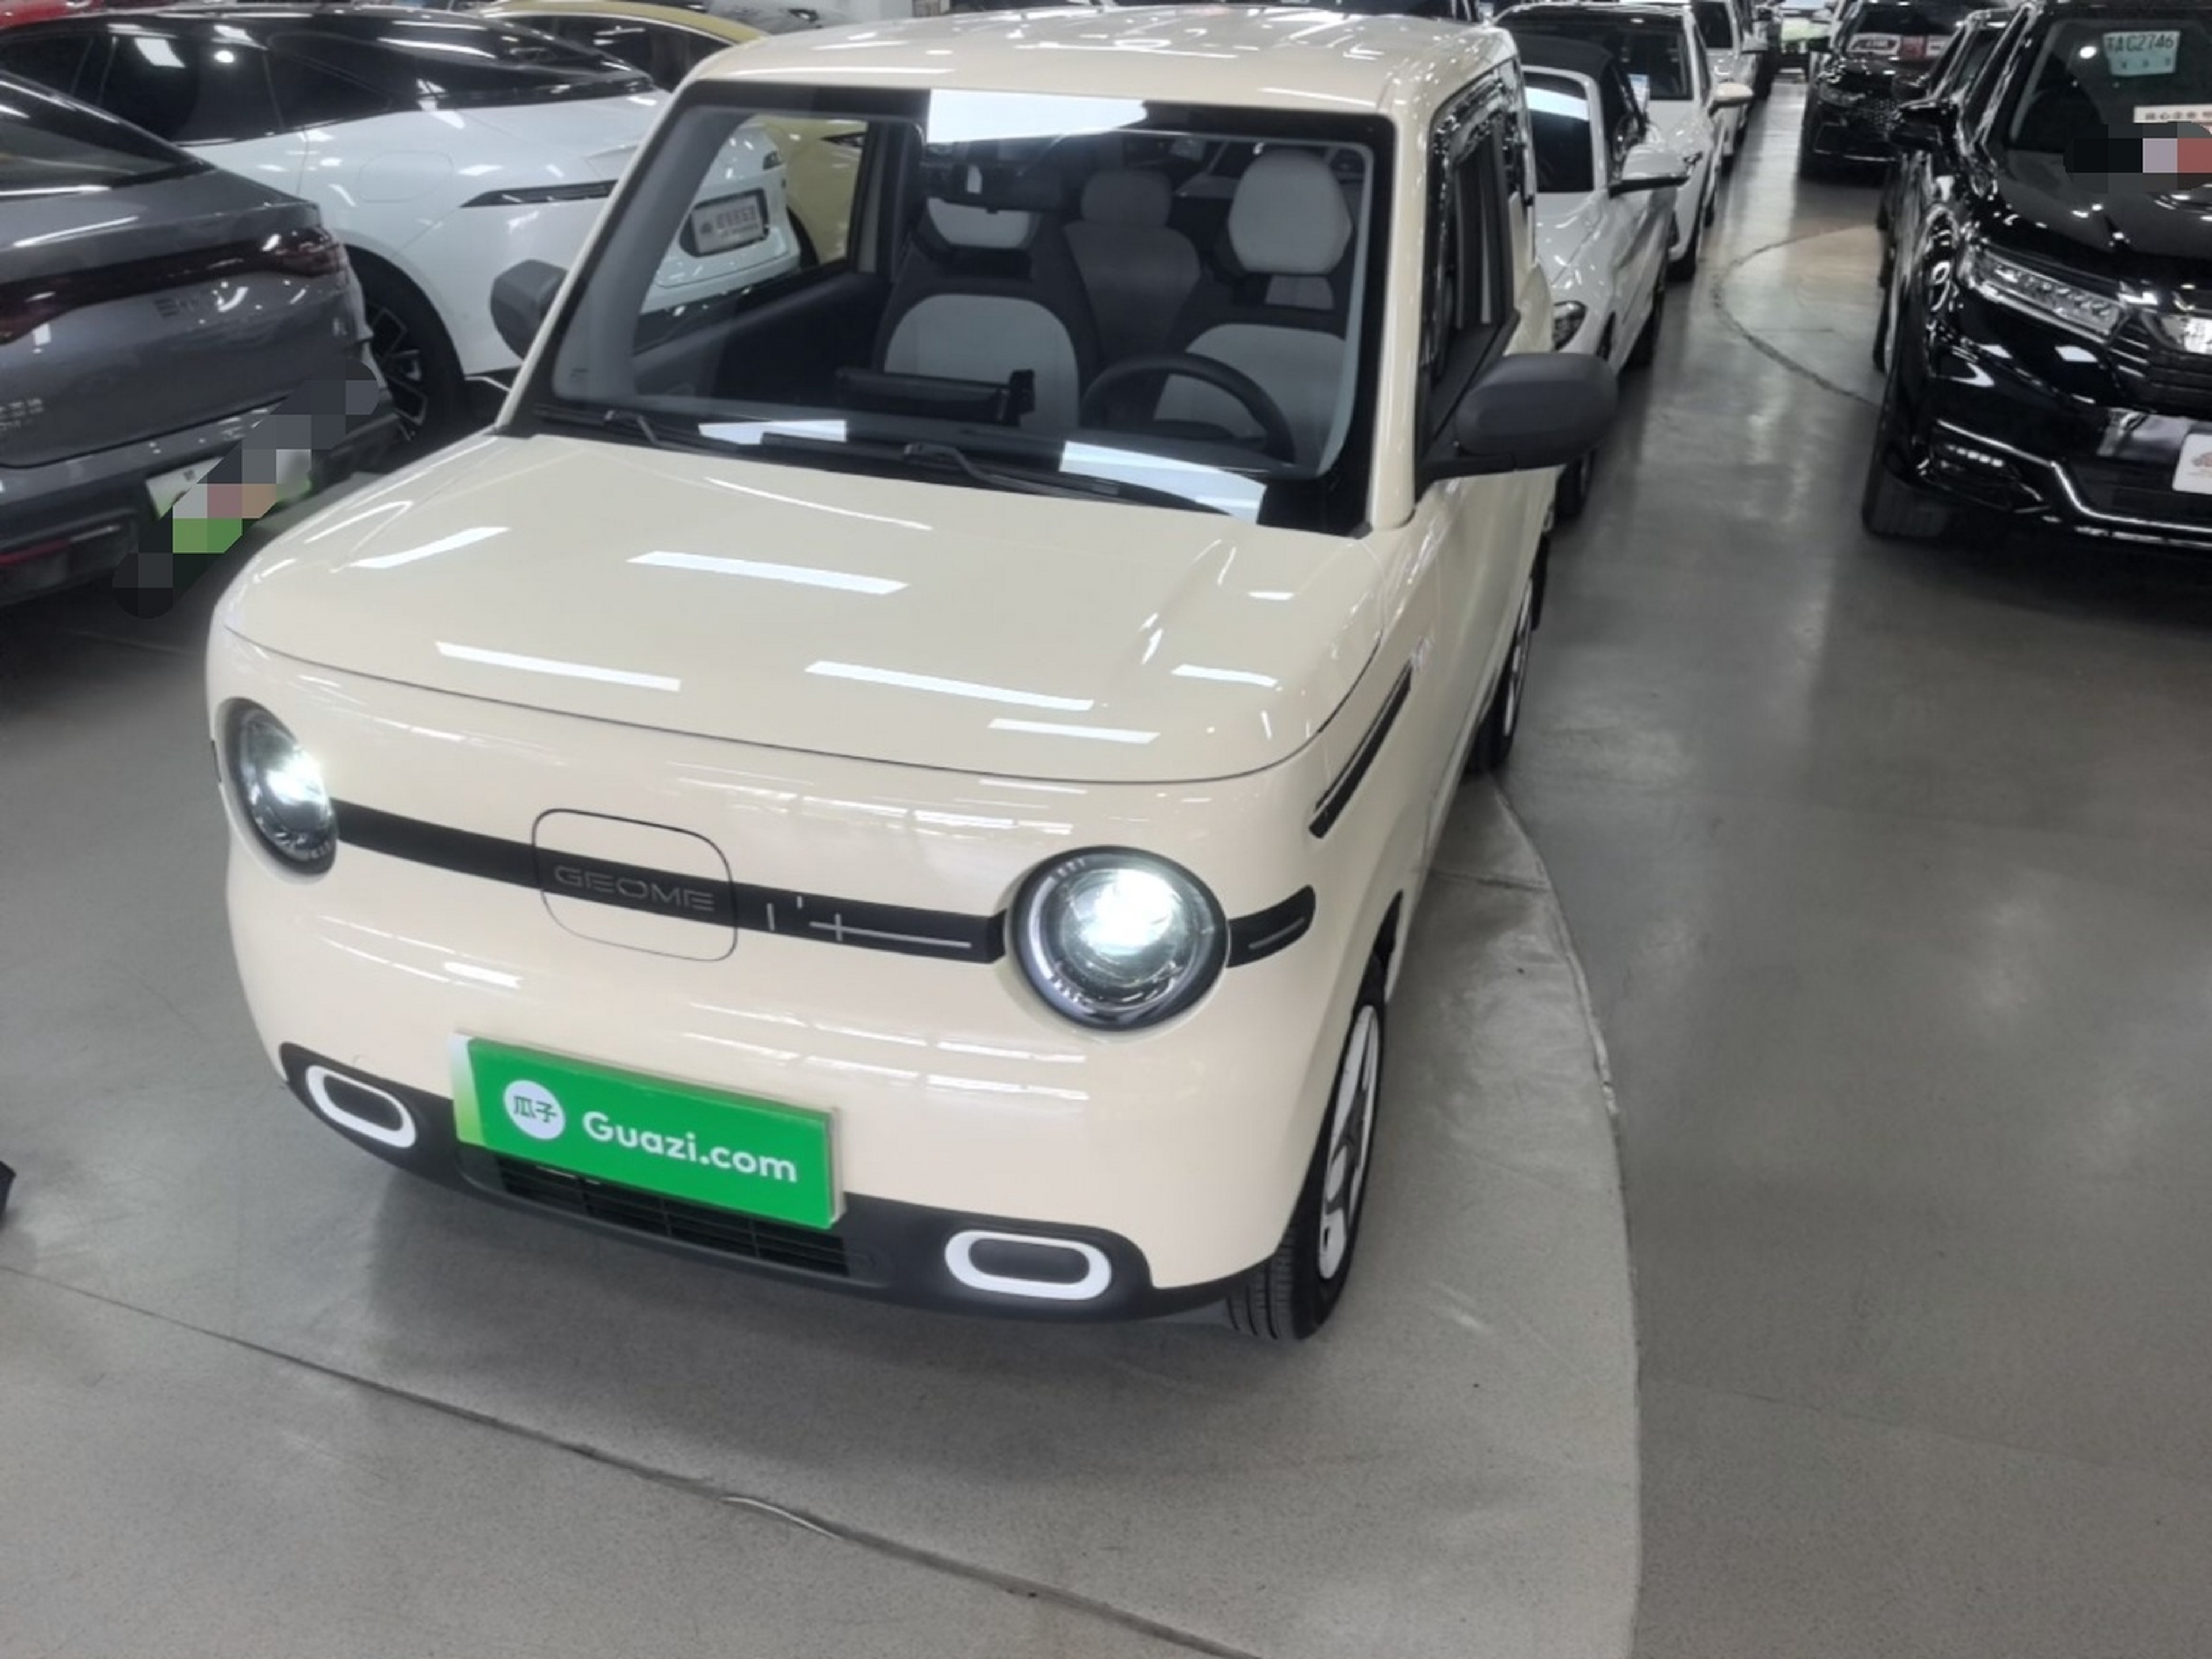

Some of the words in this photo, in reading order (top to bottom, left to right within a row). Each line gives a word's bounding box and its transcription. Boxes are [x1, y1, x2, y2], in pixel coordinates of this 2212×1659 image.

[555, 865, 714, 912] GEOME
[513, 1096, 557, 1123] 瓜子
[582, 1111, 797, 1183] Guazi.com
